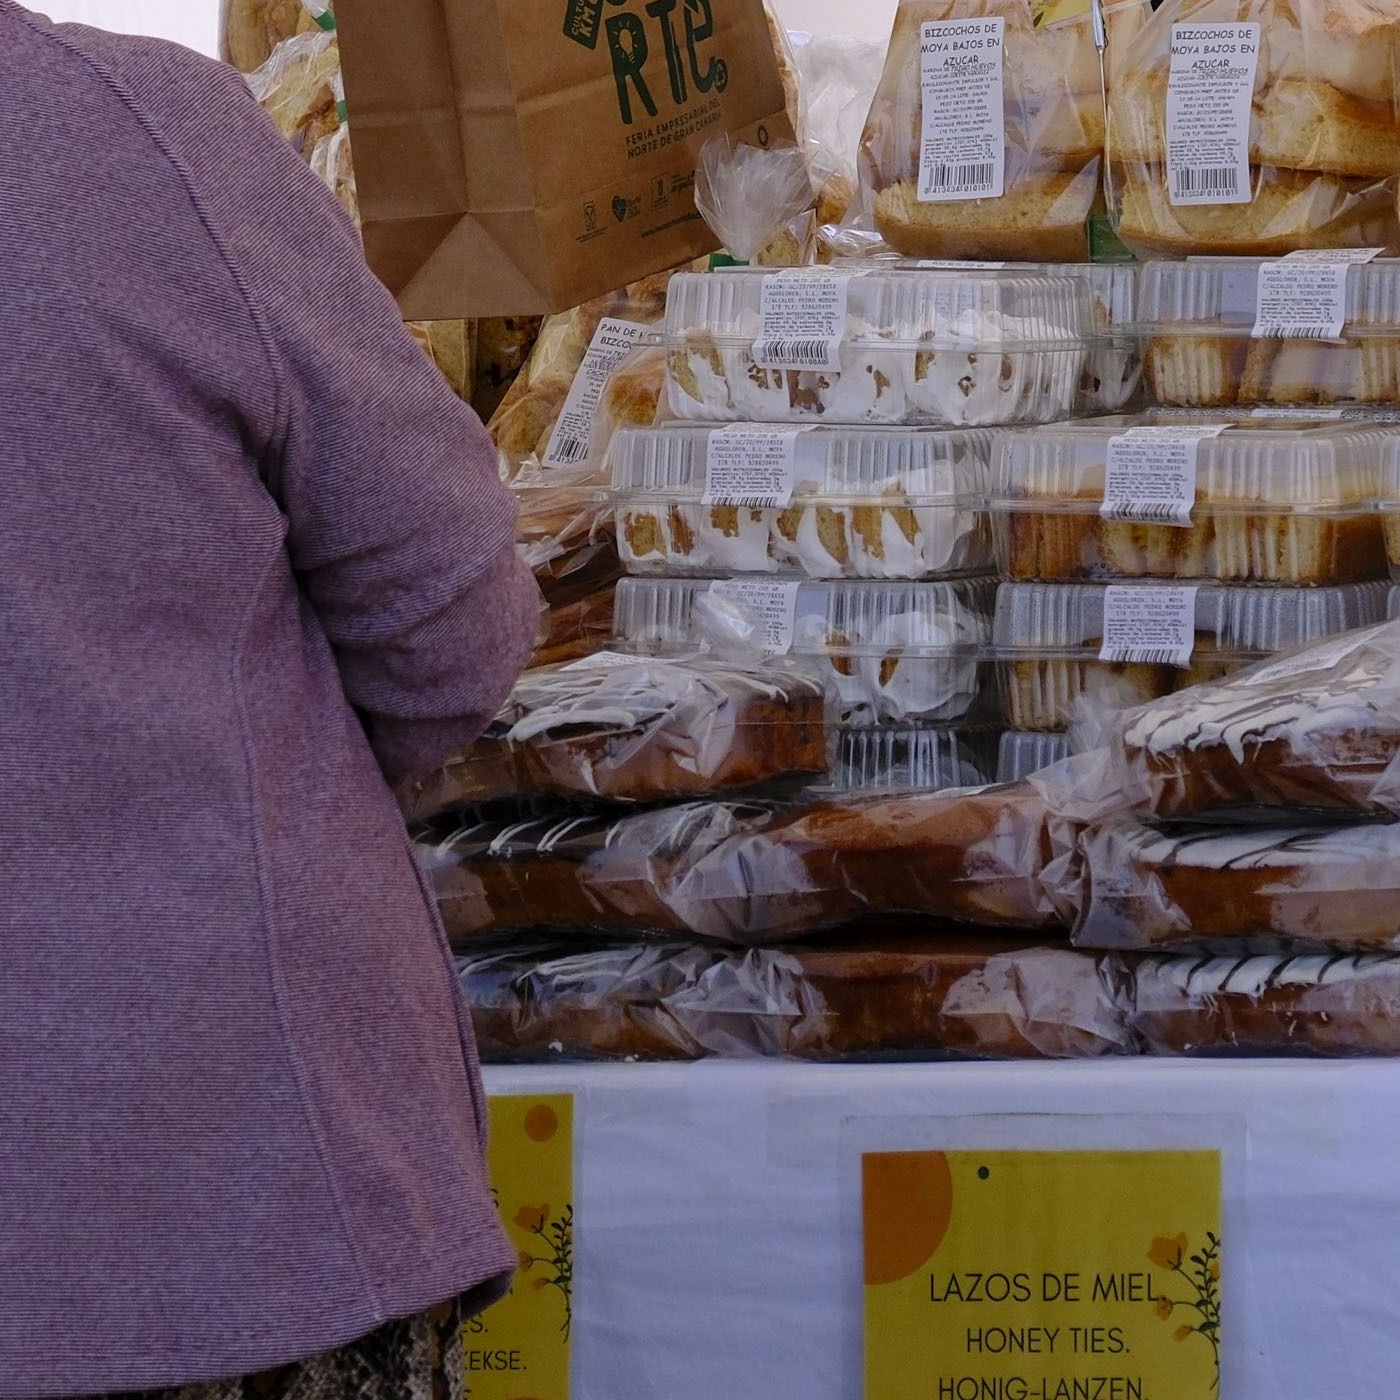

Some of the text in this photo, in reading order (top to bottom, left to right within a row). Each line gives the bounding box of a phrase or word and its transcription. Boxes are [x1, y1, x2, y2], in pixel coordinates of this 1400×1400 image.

[924, 24, 997, 38] BIZCOCHOS DE
[1176, 29, 1252, 40] BIZCOCHOS DE
[920, 38, 1000, 53] MOYA BAJOS EN
[1171, 44, 1255, 55] MOYA BAJOS EN
[943, 55, 979, 66] AZUCAR
[1192, 59, 1230, 69] AZUCAR
[625, 128, 654, 147] FERIA
[656, 104, 709, 136] EMPRESARIAL
[627, 141, 659, 160] NORTE
[660, 135, 672, 148] DE
[673, 127, 695, 142] GRAN
[600, 323, 636, 338] PAN DE
[930, 1273, 1031, 1302] LAZOS
[1042, 1273, 1080, 1302] DE
[967, 1327, 1131, 1353] HONEY TIES.
[464, 1351, 528, 1371] EKSE.
